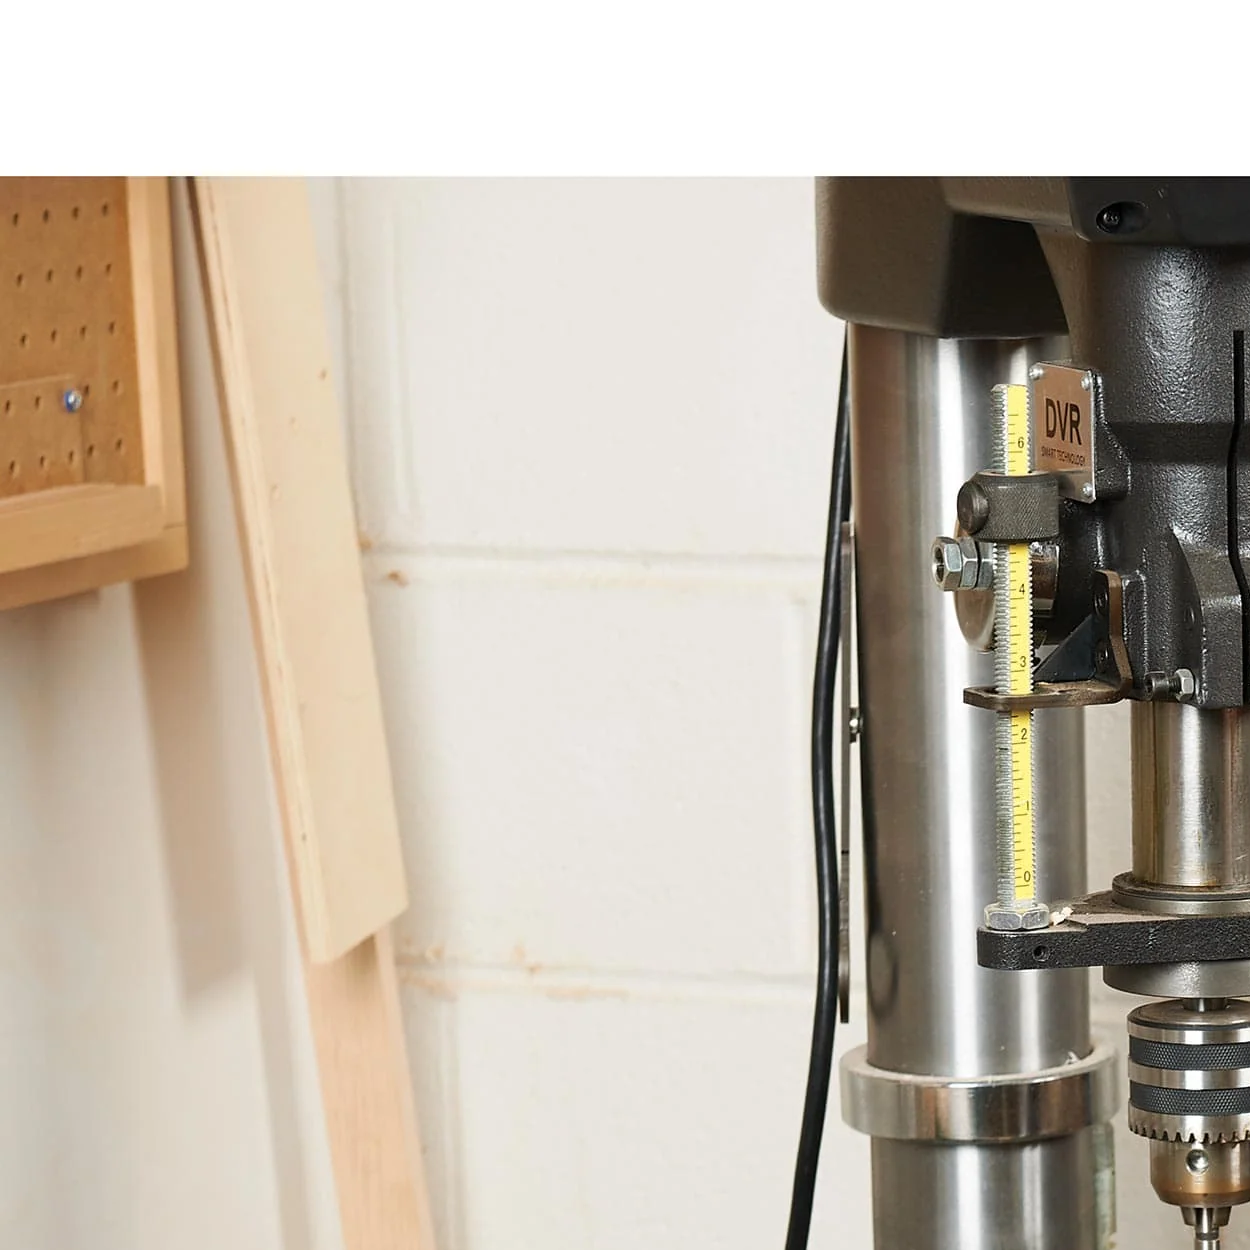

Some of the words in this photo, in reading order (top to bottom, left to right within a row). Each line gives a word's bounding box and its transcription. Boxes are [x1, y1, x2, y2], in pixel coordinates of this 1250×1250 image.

[1045, 397, 1082, 446] DVR
[1017, 436, 1025, 448] 6
[1018, 583, 1026, 595] 4
[1019, 655, 1027, 668] 3
[1020, 728, 1028, 740] 2
[1023, 870, 1031, 883] 0
